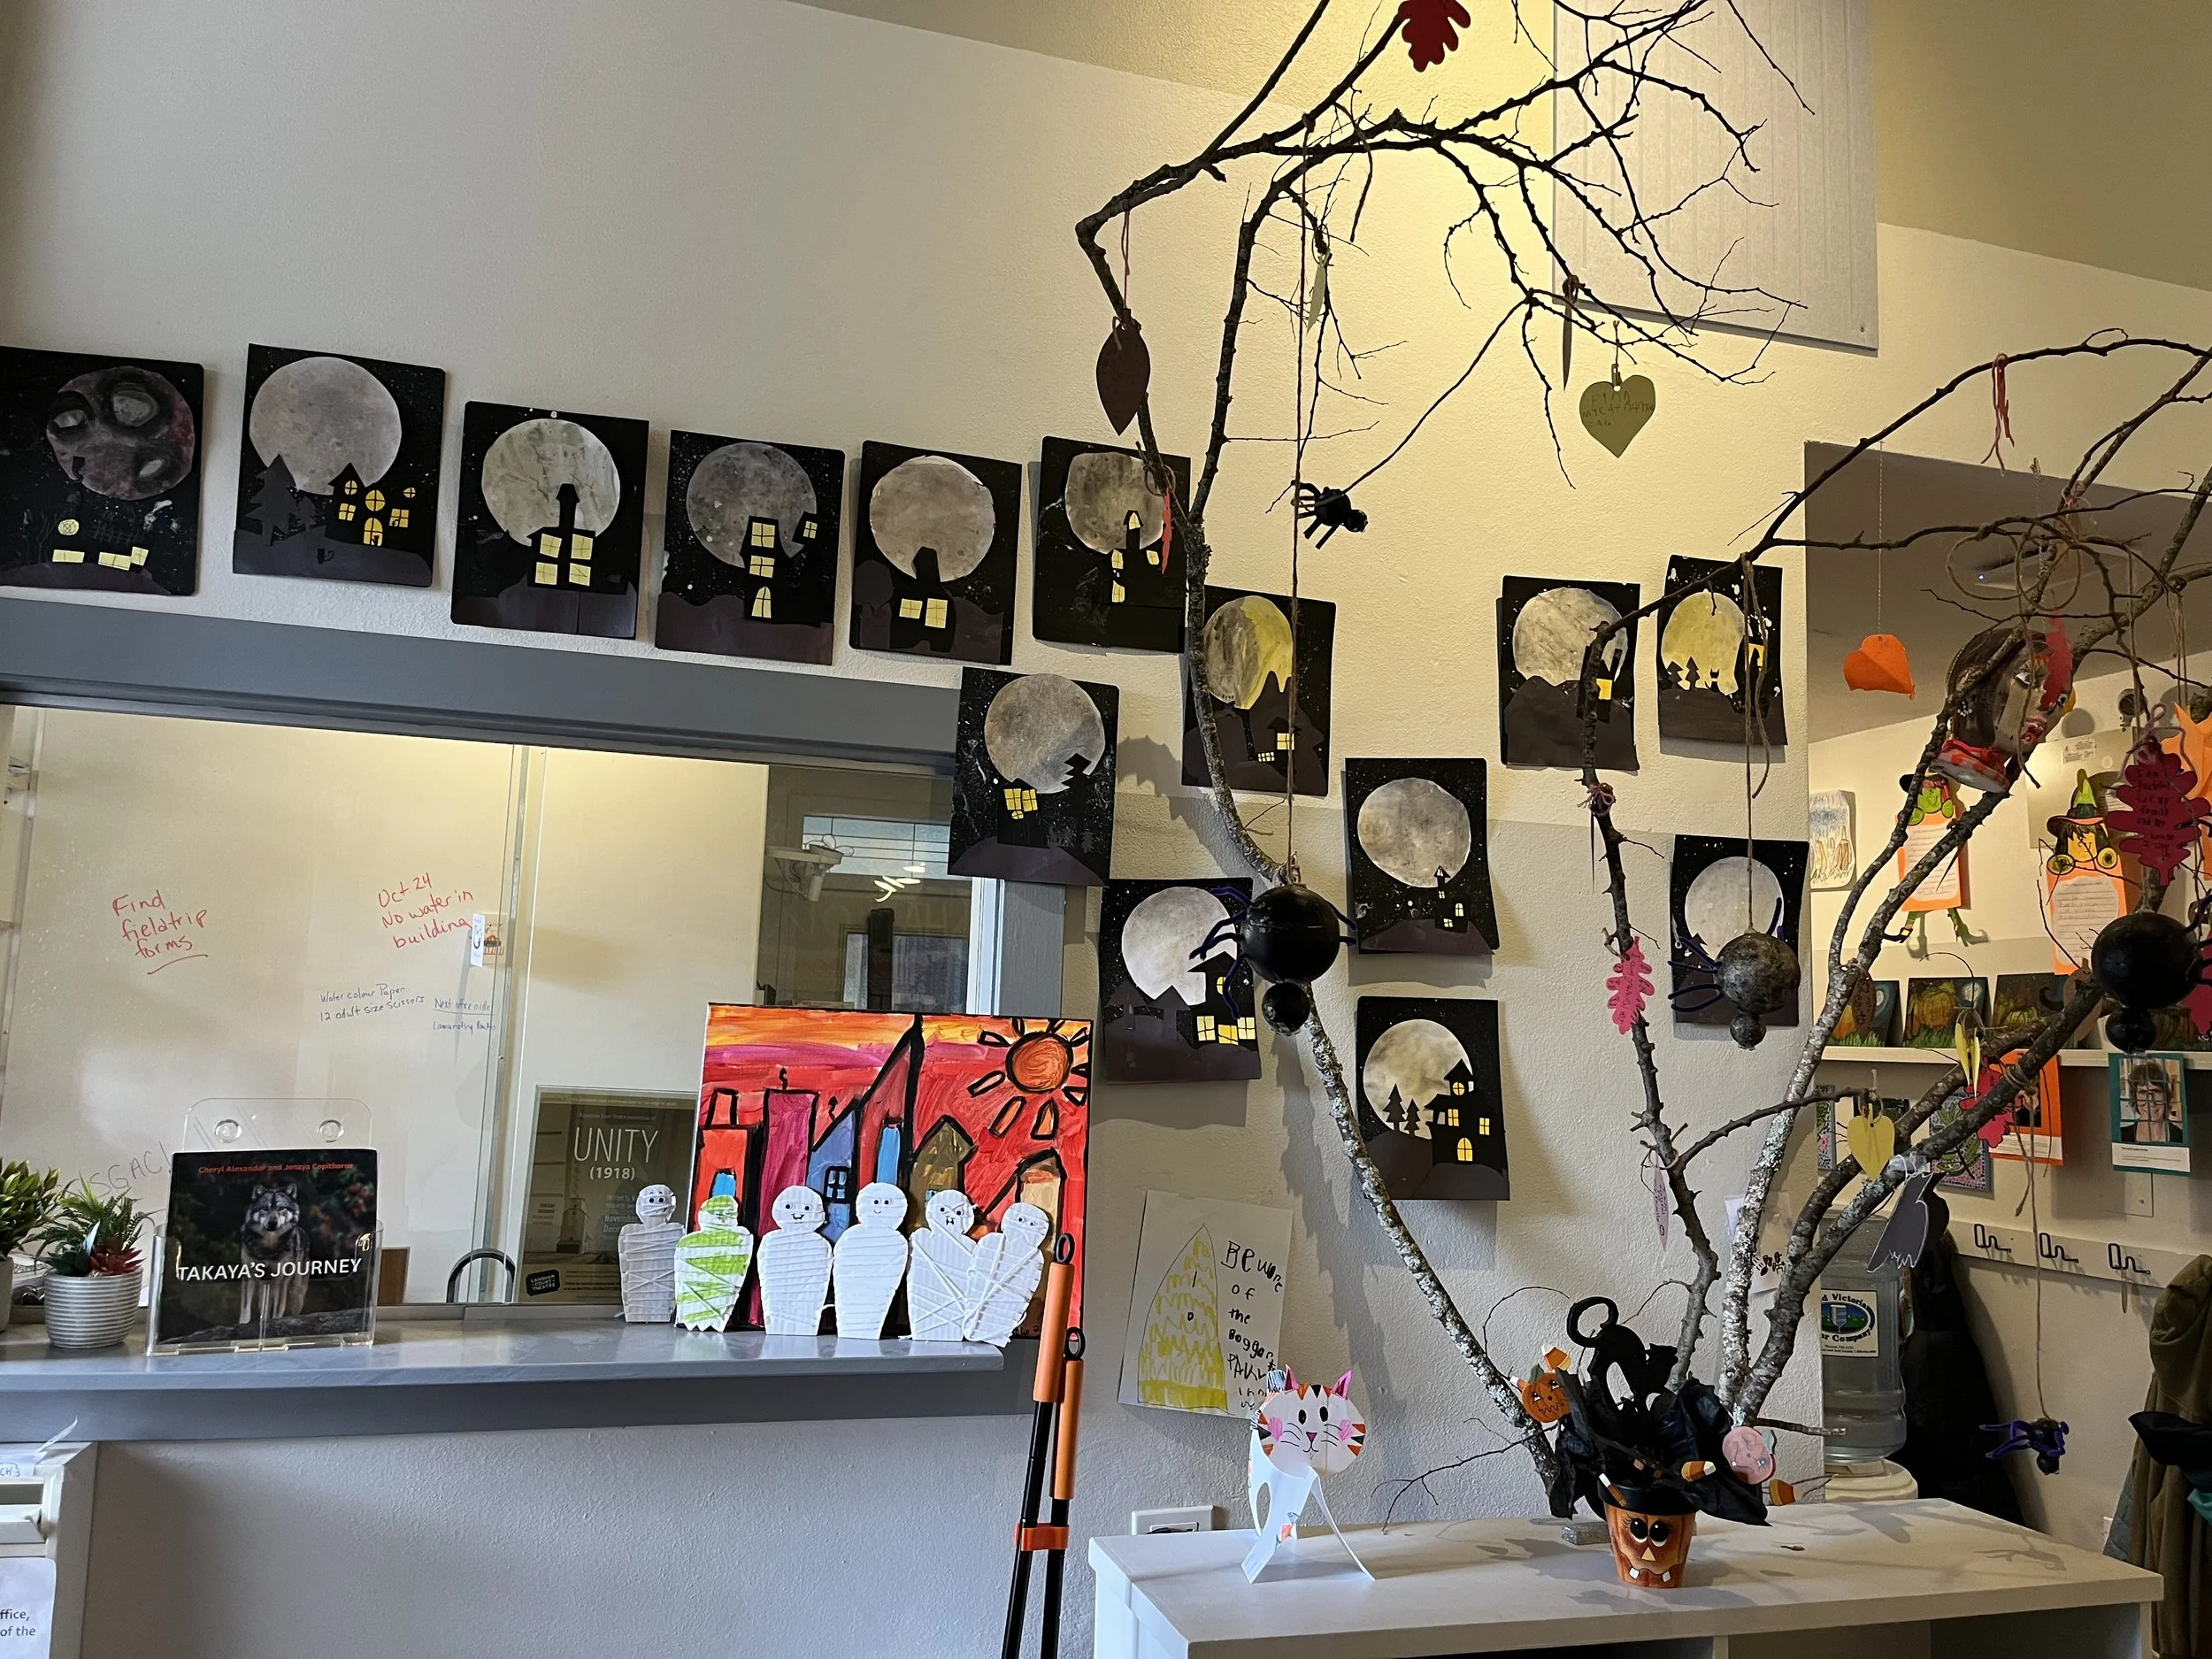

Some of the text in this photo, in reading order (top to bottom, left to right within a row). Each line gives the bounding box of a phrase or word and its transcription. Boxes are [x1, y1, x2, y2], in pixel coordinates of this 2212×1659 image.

[412, 872, 432, 890] 24
[112, 889, 165, 917] Find
[381, 889, 473, 928] No water in
[393, 918, 473, 949] building
[134, 935, 193, 959] forms
[376, 983, 406, 1001] Paper
[320, 1011, 332, 1022] 12
[574, 1126, 658, 1164] UNITY
[589, 1166, 635, 1180] (1918)
[179, 1258, 362, 1281] TAKAYA'S JOURNEY
[1232, 1284, 1256, 1300] of
[1228, 1308, 1251, 1325] the
[1832, 1329, 1871, 1343] Company
[0, 1625, 36, 1637] of the
